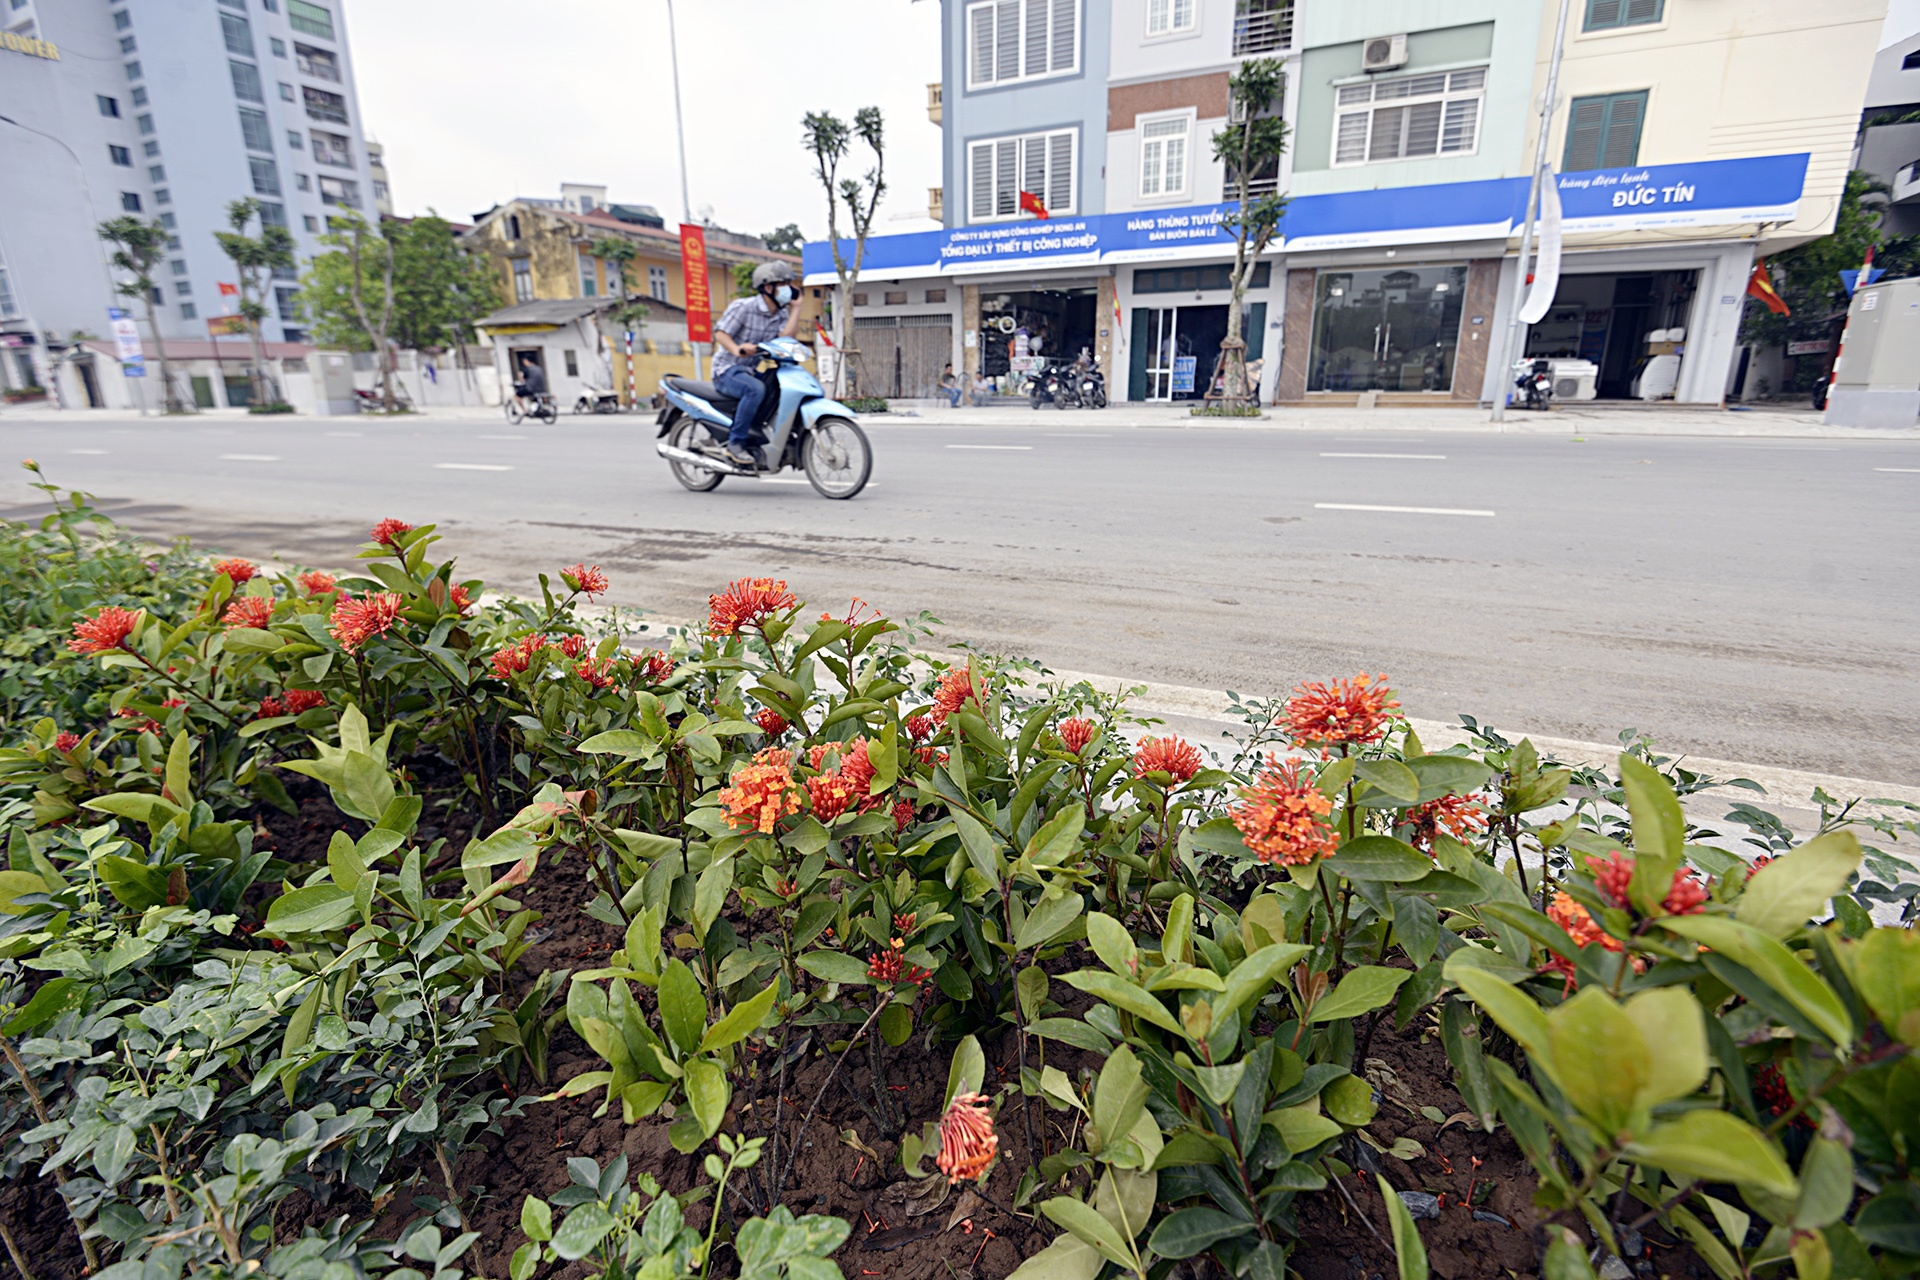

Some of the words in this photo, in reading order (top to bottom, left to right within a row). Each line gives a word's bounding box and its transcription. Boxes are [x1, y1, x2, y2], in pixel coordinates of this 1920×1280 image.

[0, 31, 61, 62] OWER
[1612, 183, 1658, 208] ĐỨC
[1661, 181, 1696, 204] TÍN
[1127, 217, 1155, 231] HÀNG
[1157, 214, 1189, 229] THÙNG
[941, 242, 964, 258] TỔNG
[995, 239, 1020, 253] THIẾT
[1022, 240, 1032, 254] BỊ
[1033, 236, 1061, 250] CÔNG
[1062, 233, 1098, 249] NGHIỆP
